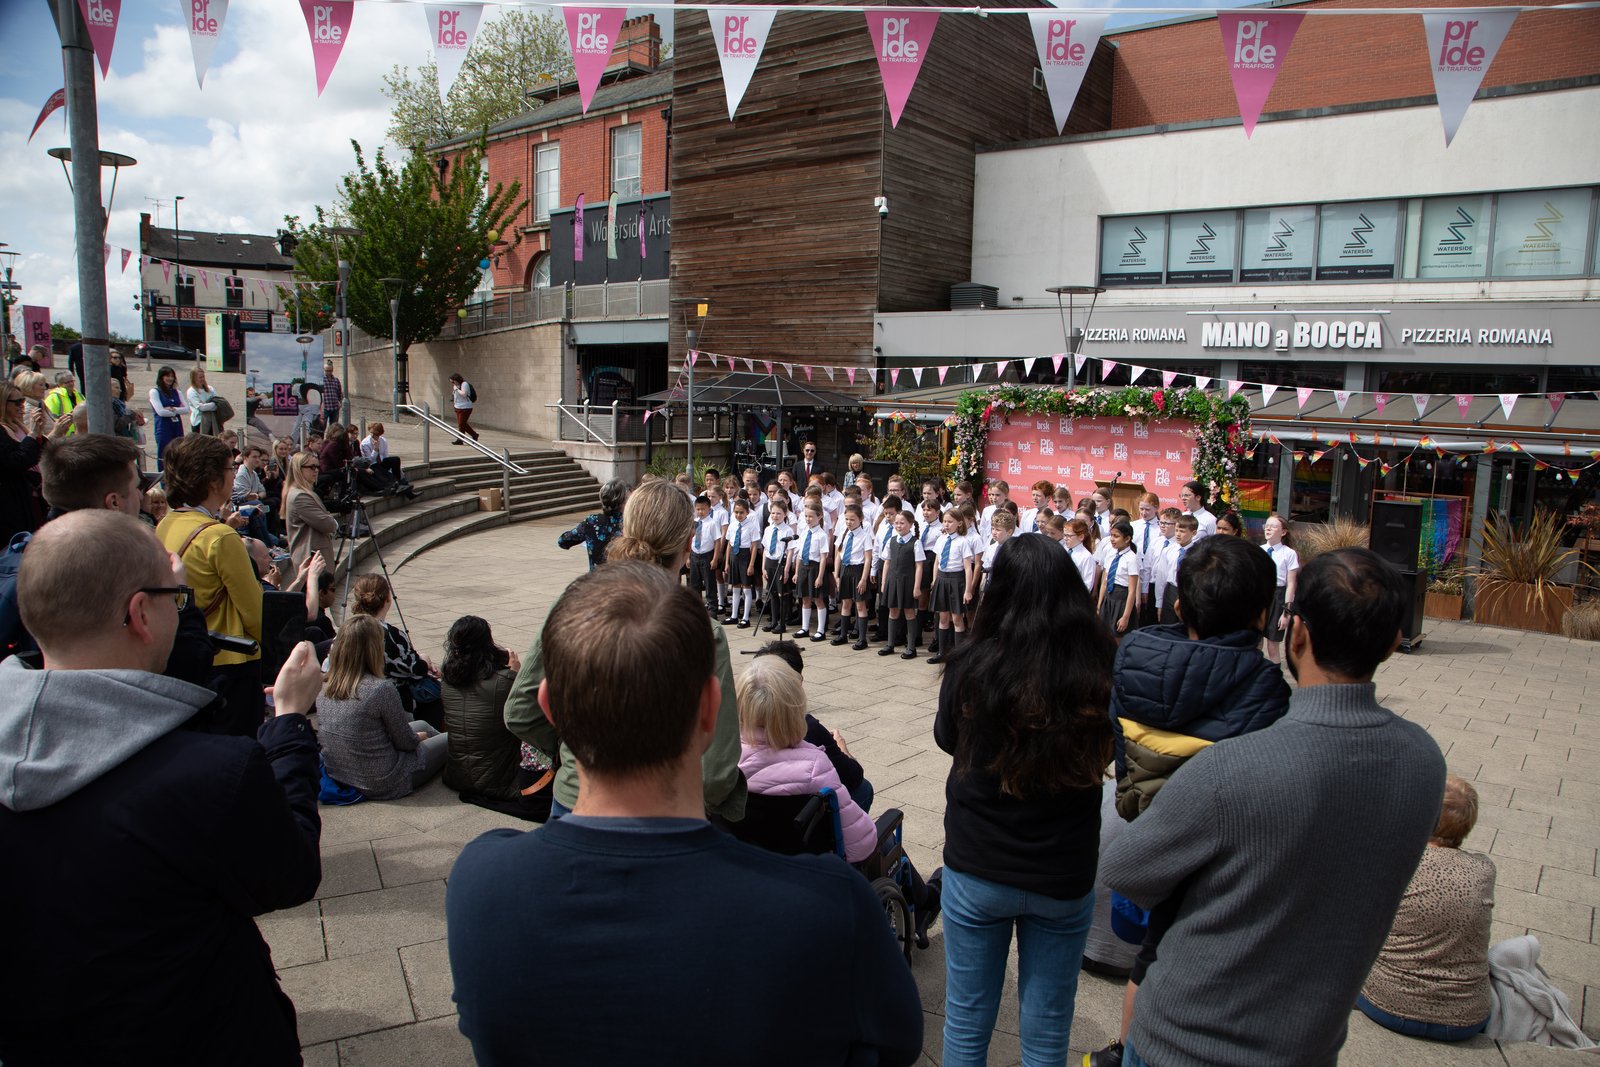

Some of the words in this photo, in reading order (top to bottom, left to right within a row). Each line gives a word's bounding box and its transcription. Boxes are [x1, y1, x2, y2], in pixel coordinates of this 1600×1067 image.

[1132, 328, 1186, 341] ROMANA
[1202, 321, 1271, 348] MANO
[1275, 329, 1289, 351] a
[1293, 321, 1382, 348] BOCCA
[1401, 328, 1472, 344] PIZZERIA
[1478, 328, 1553, 344] ROMANA
[1037, 421, 1050, 430] brsk
[1111, 424, 1124, 434] brsk
[1018, 441, 1031, 450] brsk
[1091, 446, 1105, 455] brsk
[1166, 450, 1180, 460] brsk
[987, 460, 1000, 470] brsk
[1058, 465, 1071, 475] brsk
[1132, 471, 1145, 480] brsk
